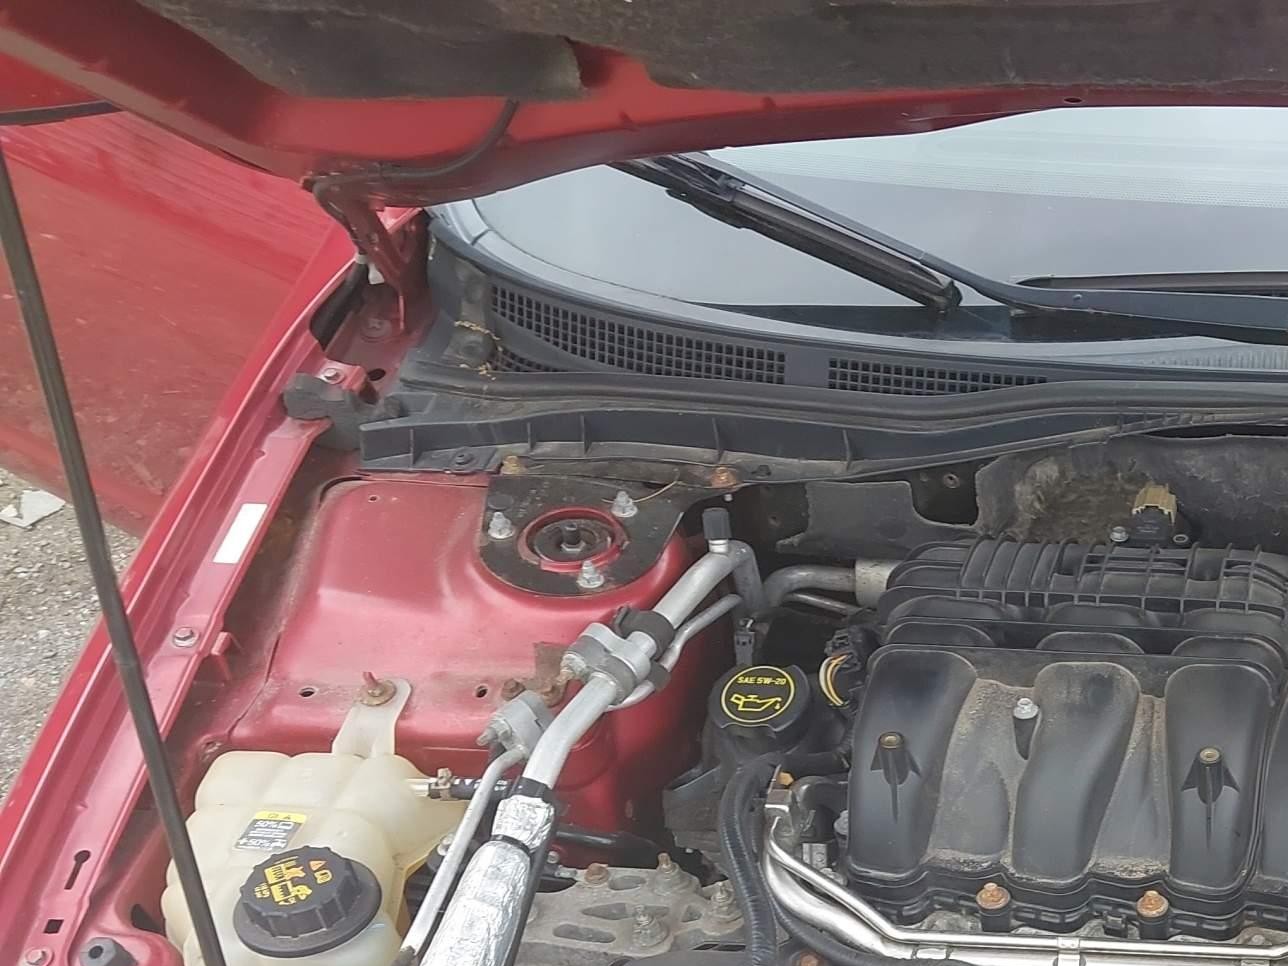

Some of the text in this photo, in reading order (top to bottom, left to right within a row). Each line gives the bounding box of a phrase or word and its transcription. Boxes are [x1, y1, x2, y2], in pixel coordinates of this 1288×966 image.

[737, 676, 787, 686] SAE 5W-20
[253, 820, 279, 828] 50%
